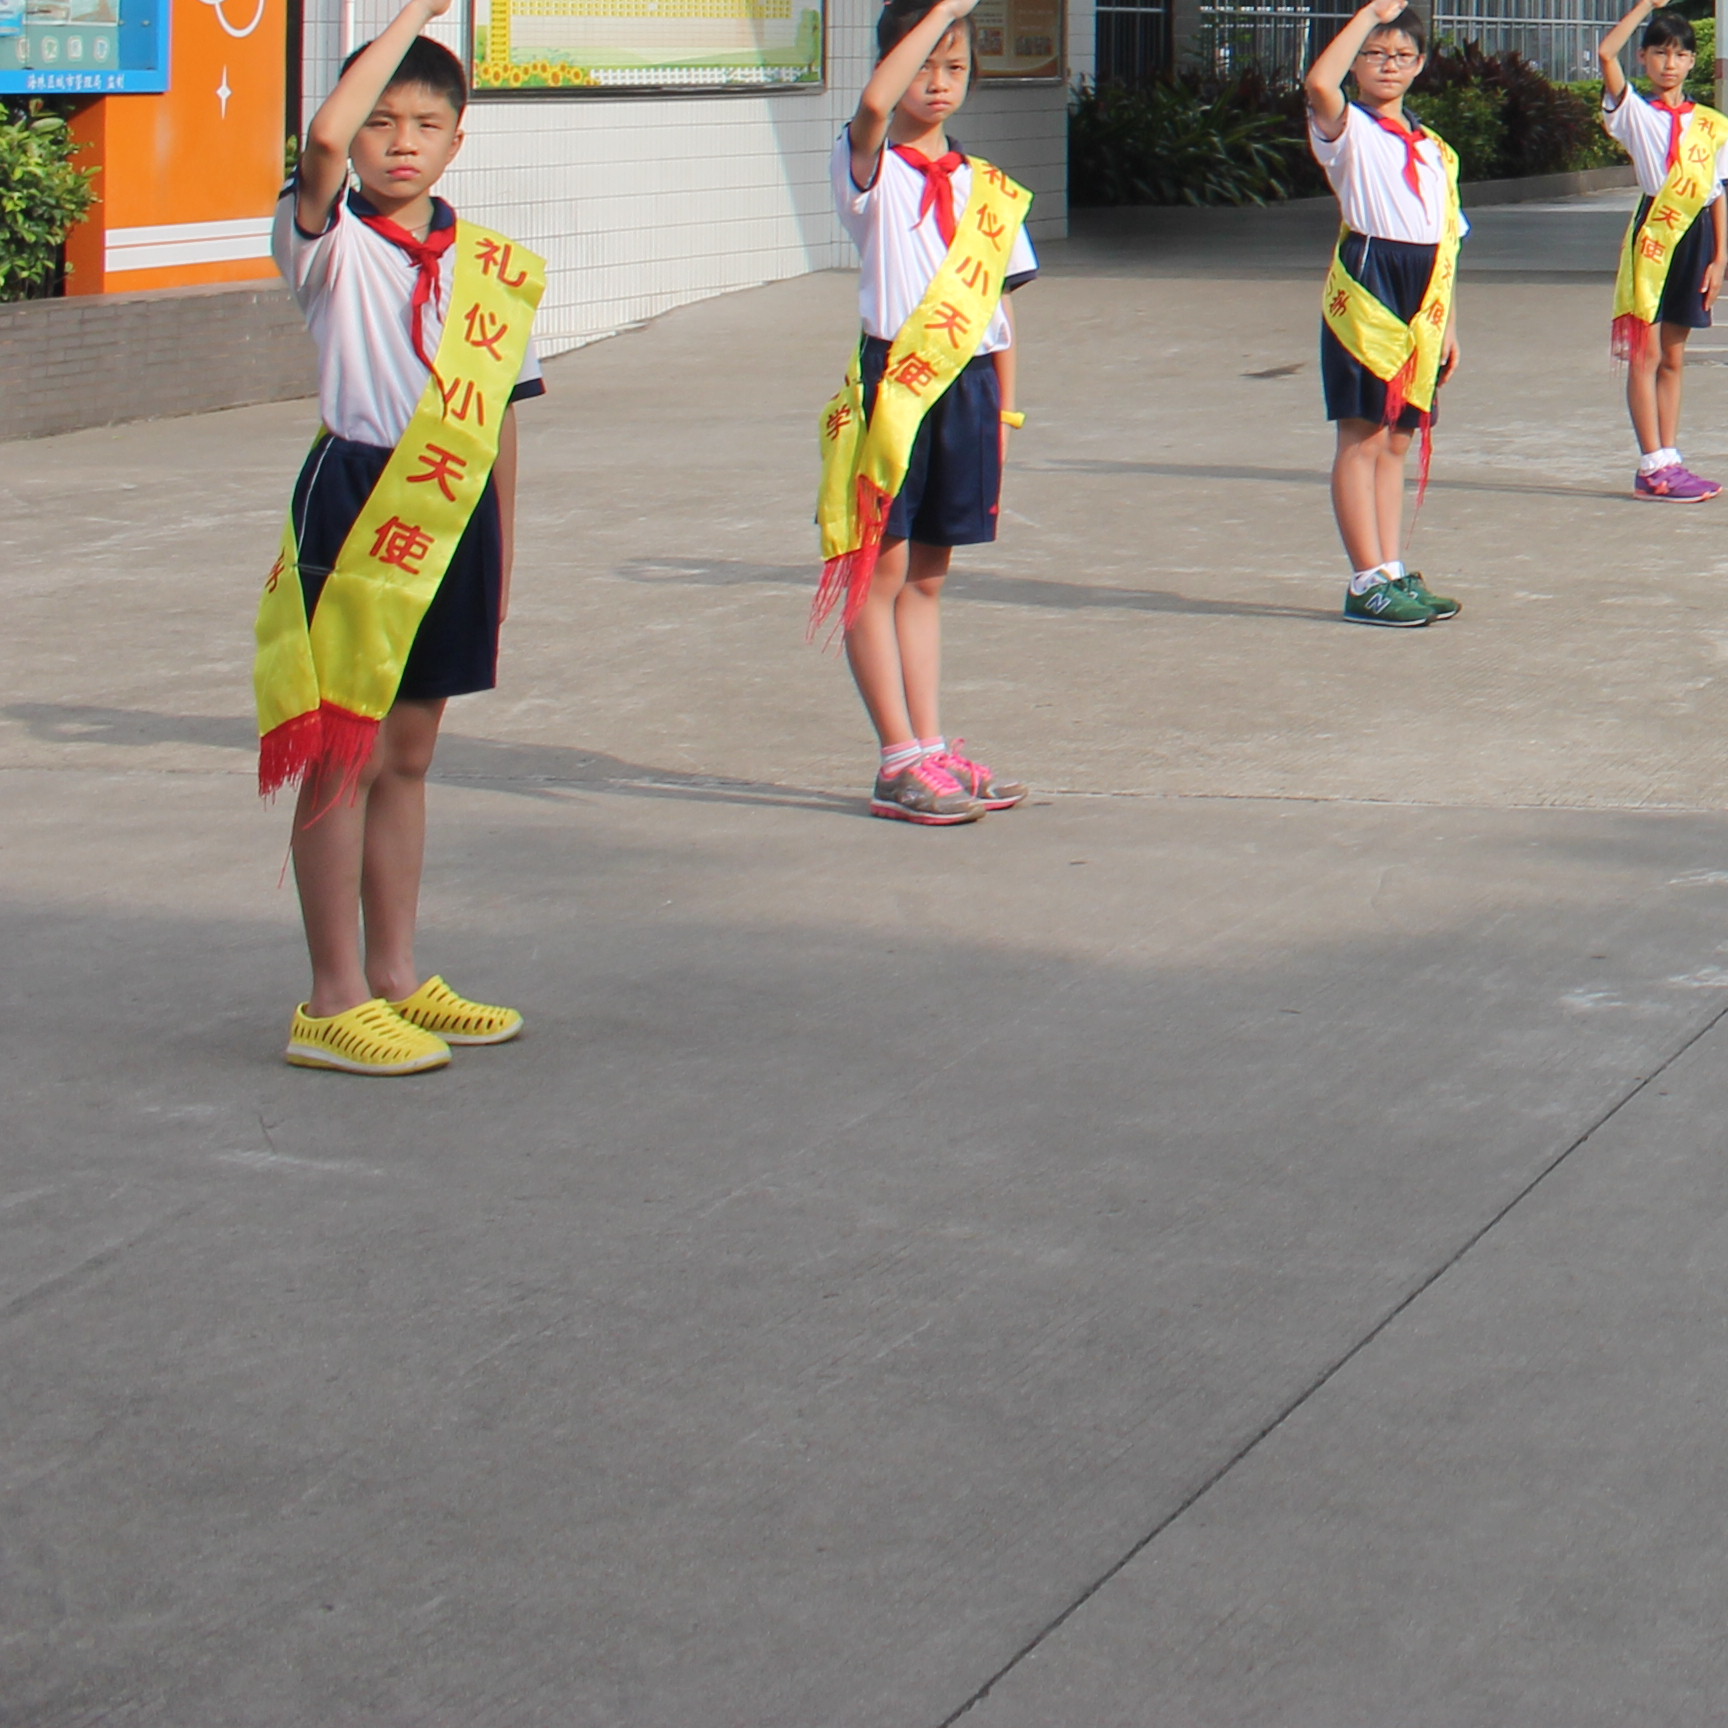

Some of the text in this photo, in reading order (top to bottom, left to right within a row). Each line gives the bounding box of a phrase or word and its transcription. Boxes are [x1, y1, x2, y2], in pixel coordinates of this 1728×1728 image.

[887, 161, 1019, 398] 礼仪小天使
[1639, 116, 1716, 265] 礼仪小天使
[369, 234, 528, 576] 礼仪小天使
